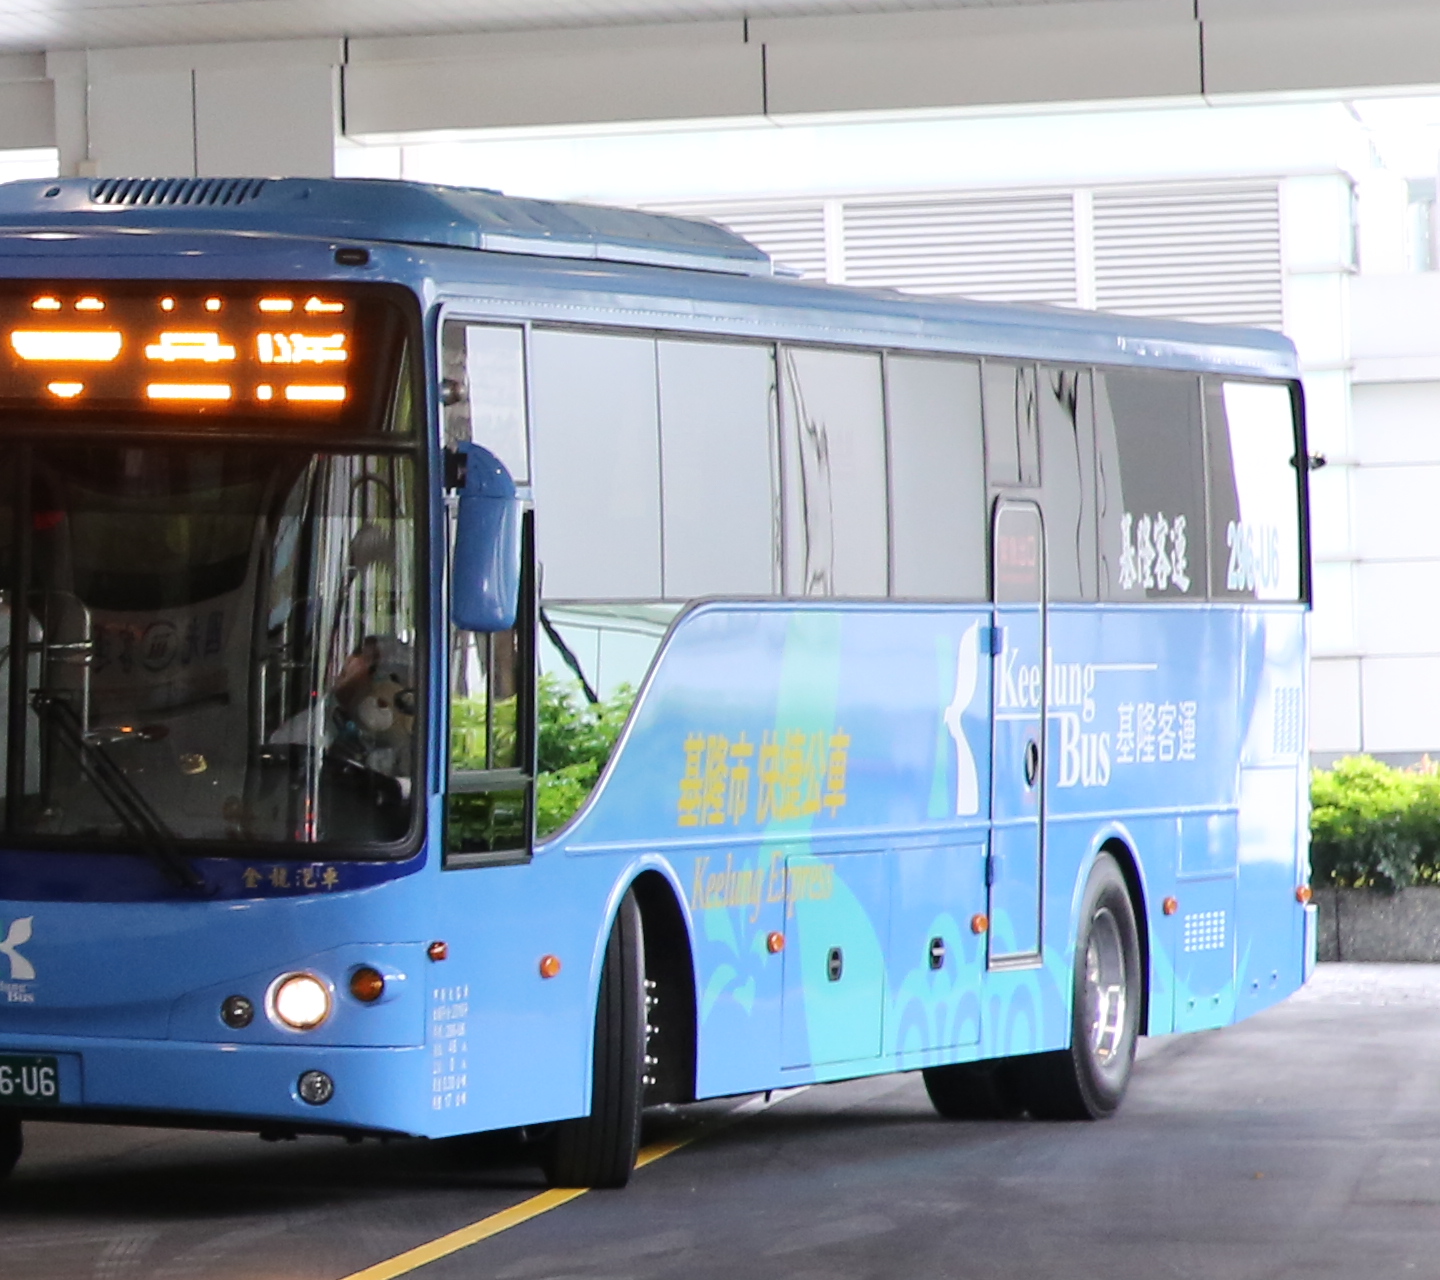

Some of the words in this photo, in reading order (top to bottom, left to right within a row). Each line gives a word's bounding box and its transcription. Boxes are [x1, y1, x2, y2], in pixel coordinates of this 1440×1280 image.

[1119, 512, 1191, 592] 基隆客運
[1227, 520, 1280, 591] 296-U6
[998, 645, 1096, 722] Keelung
[1057, 713, 1111, 787] Bus
[1115, 701, 1197, 763] 基隆客運
[691, 852, 764, 924] Keelung
